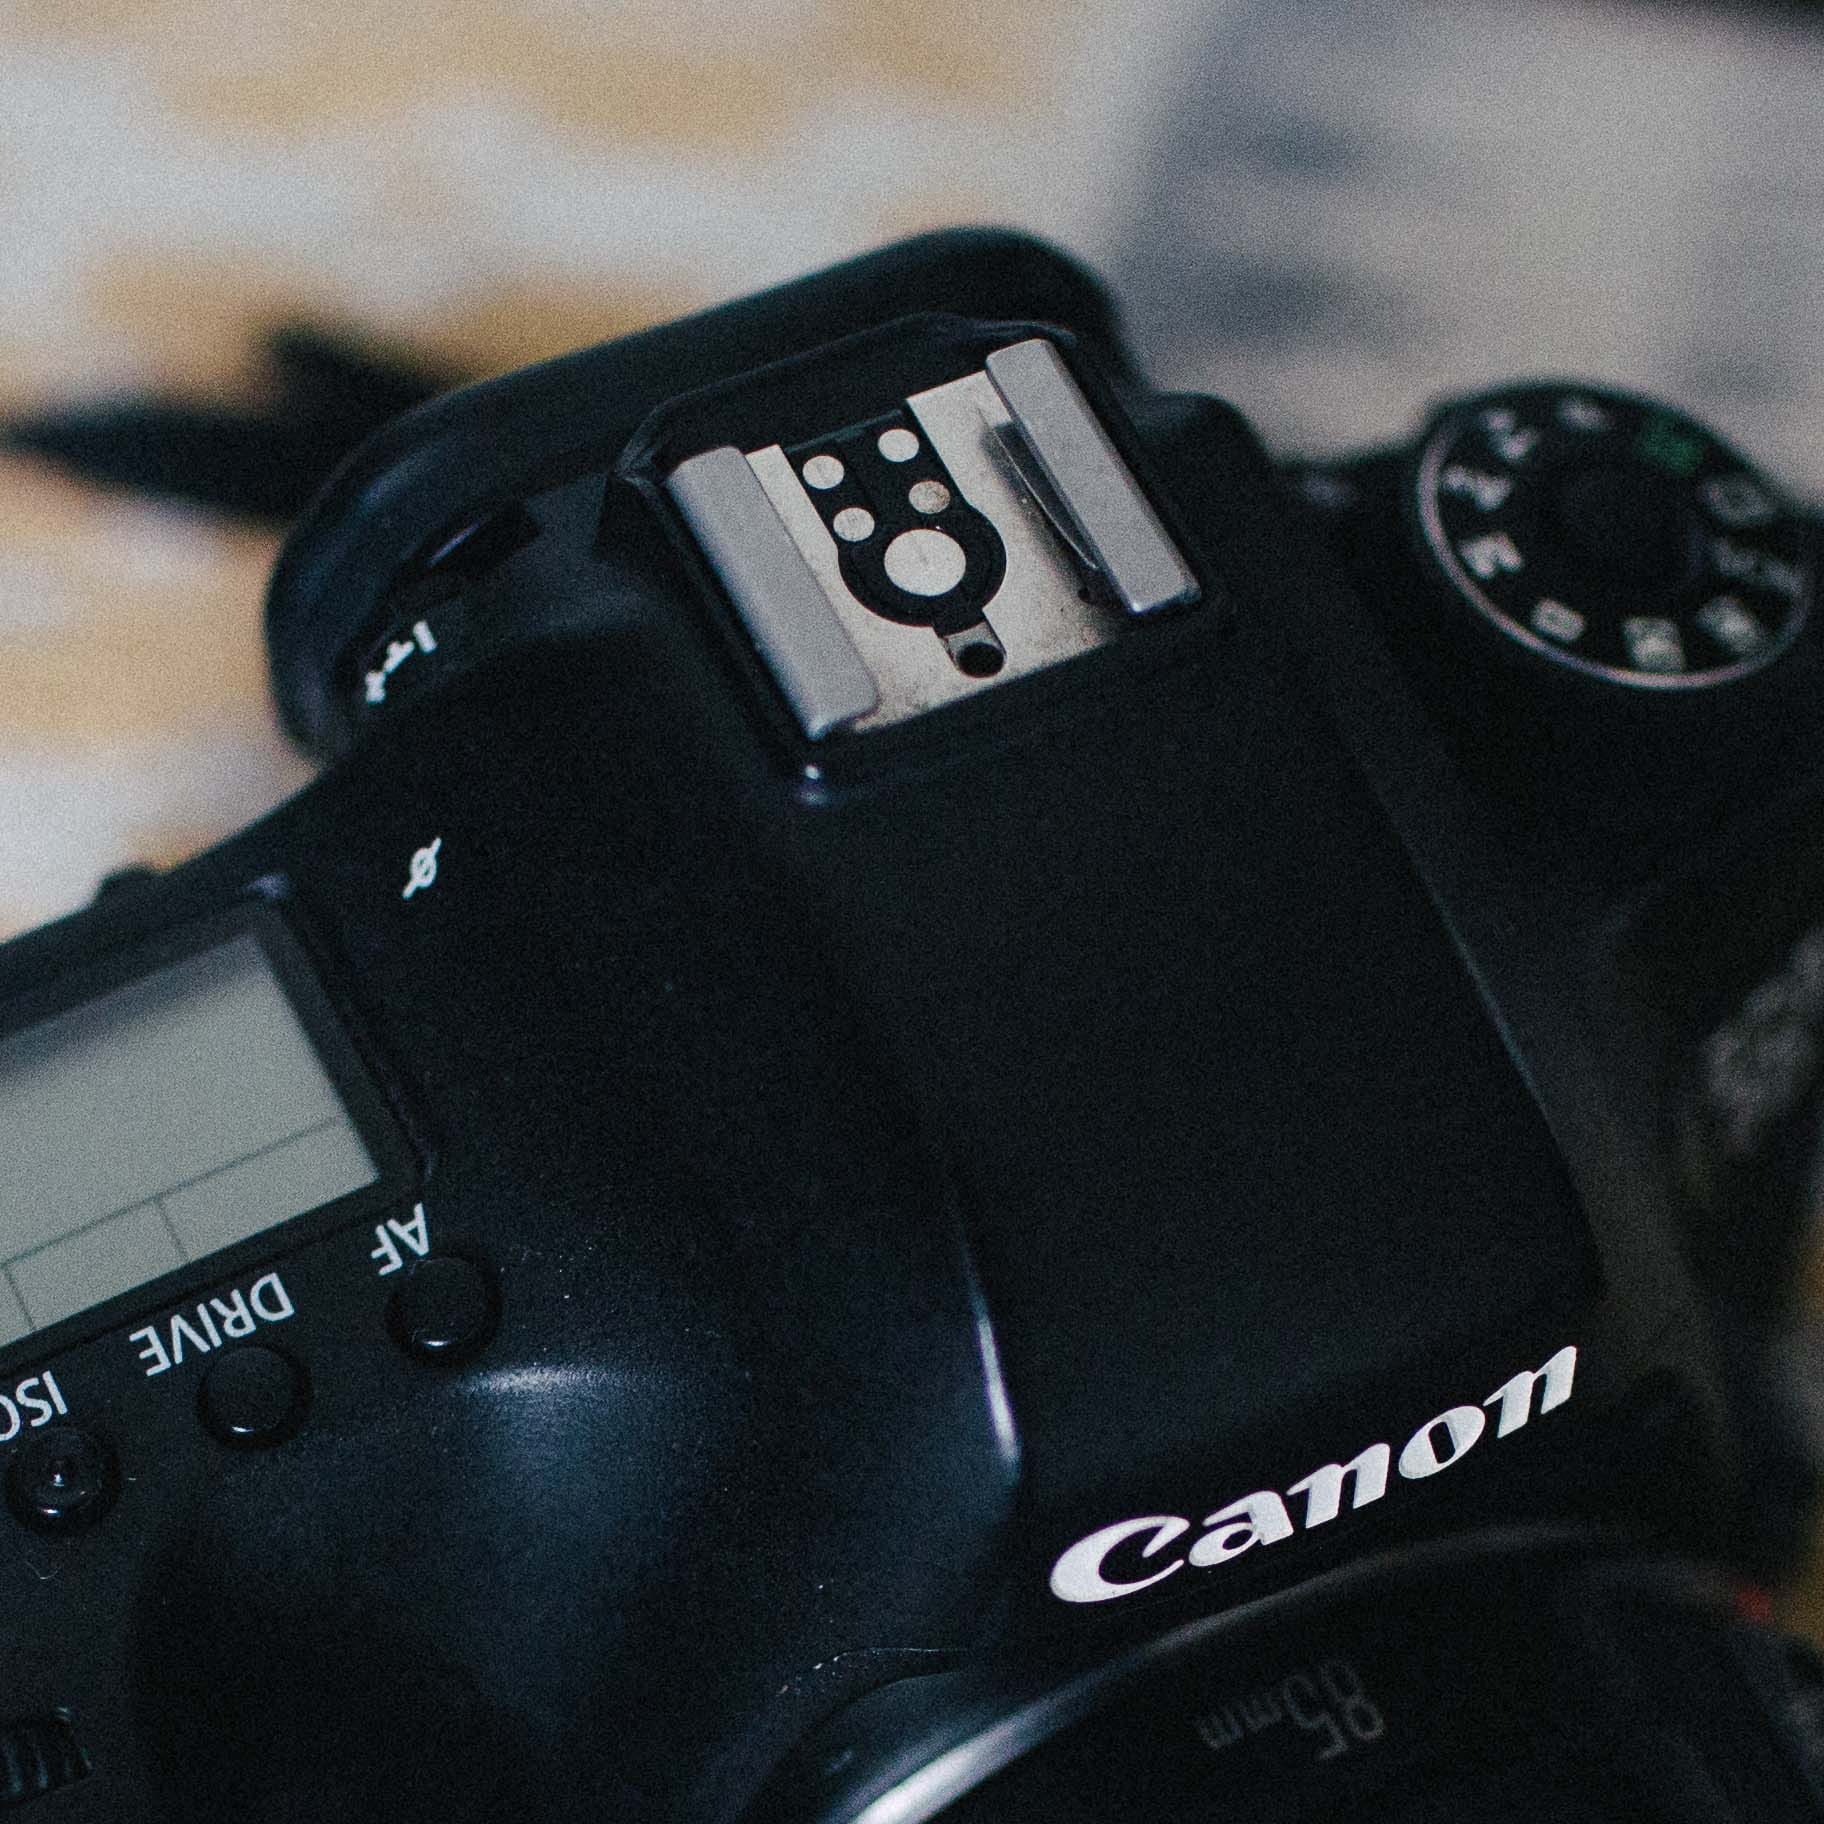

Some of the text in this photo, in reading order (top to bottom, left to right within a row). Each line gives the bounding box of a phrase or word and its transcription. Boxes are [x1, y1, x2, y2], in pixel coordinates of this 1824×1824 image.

[371, 1203, 431, 1276] AF
[129, 1272, 295, 1377] DRIVE
[1049, 1345, 1577, 1602] Canon
